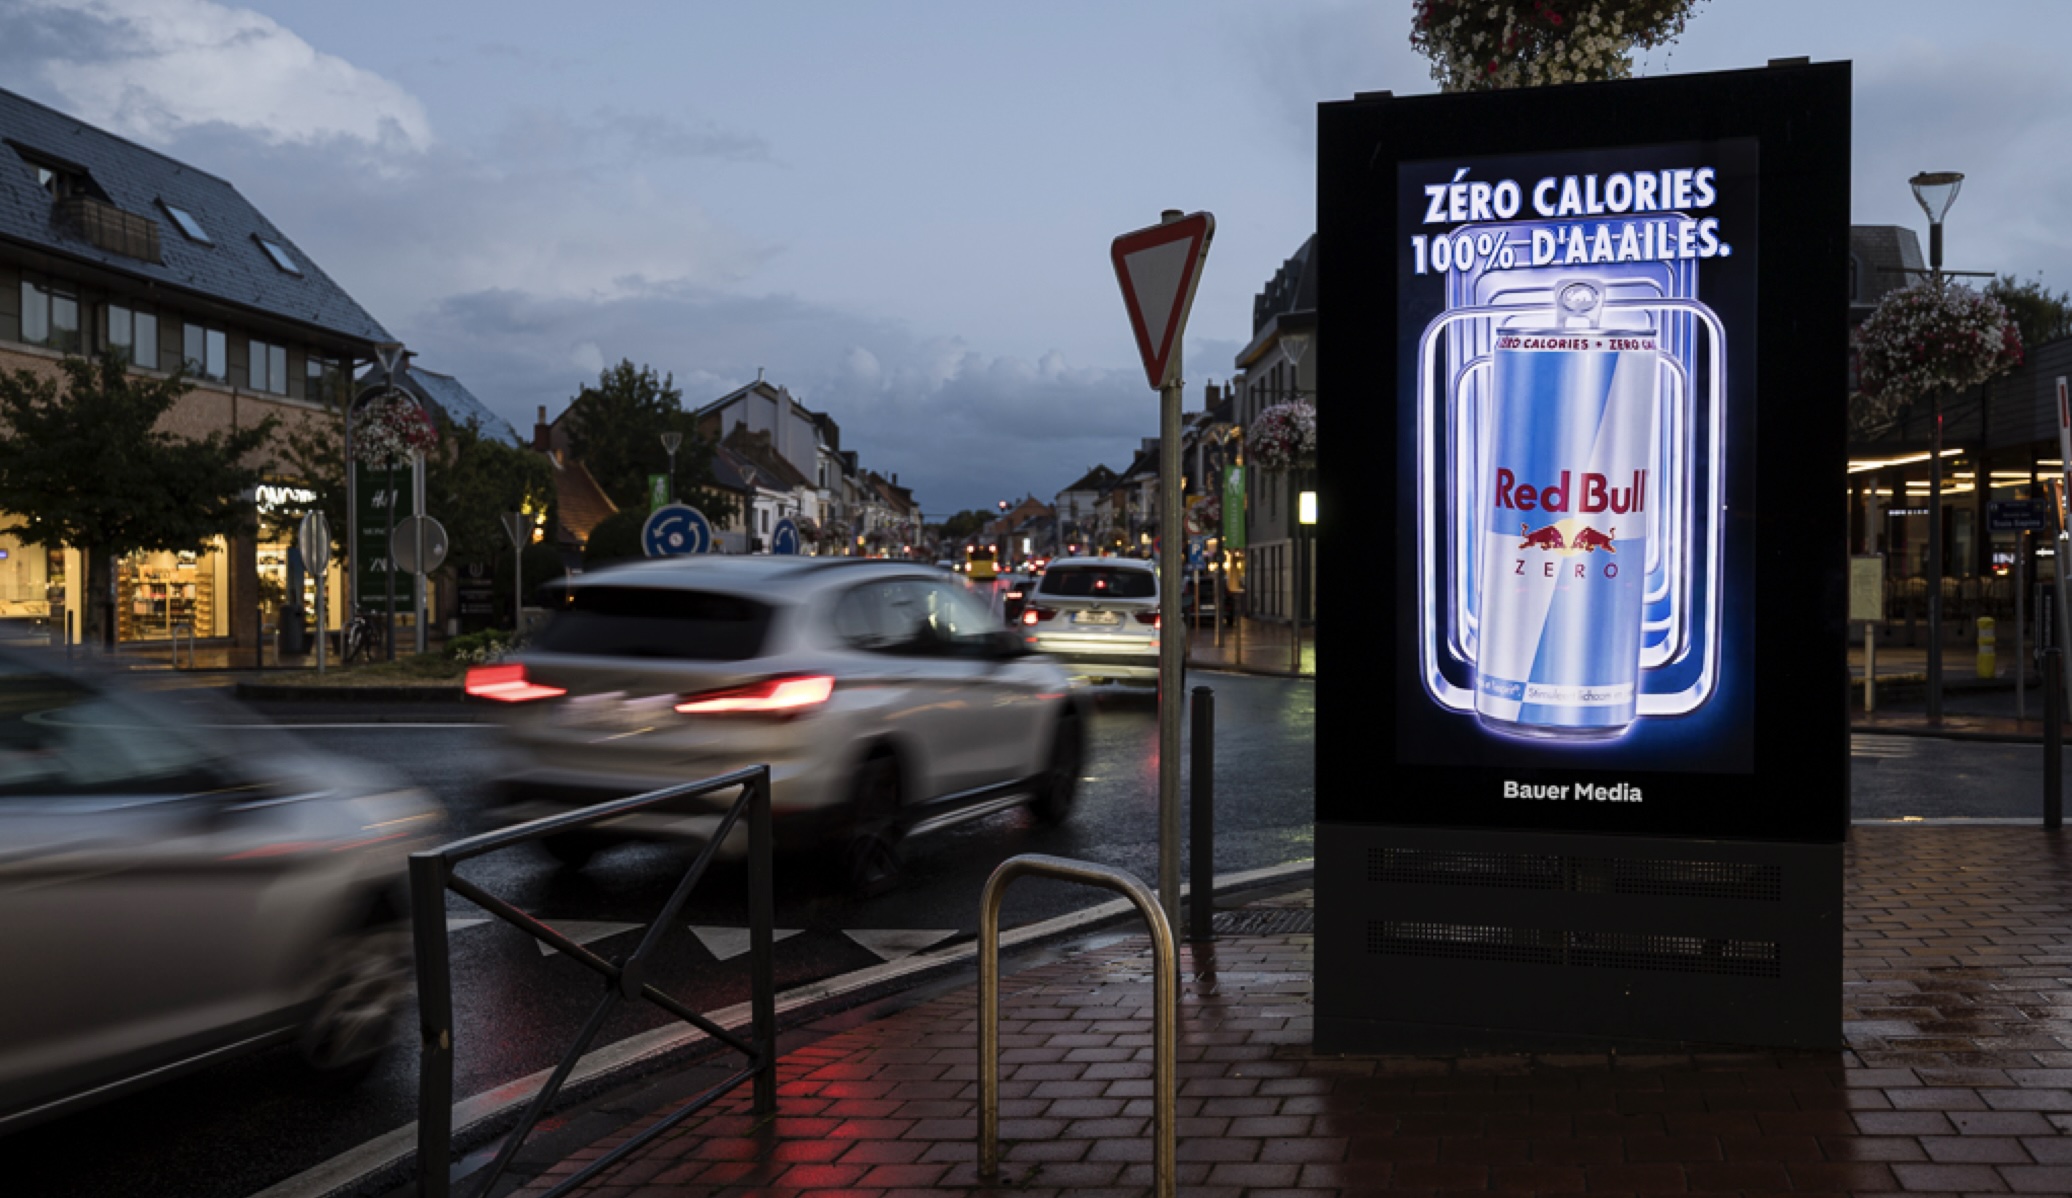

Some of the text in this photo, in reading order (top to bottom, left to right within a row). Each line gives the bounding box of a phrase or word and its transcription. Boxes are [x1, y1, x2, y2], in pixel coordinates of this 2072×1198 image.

[1423, 167, 1716, 224] ZÉRO CALORIES
[1411, 219, 1732, 275] 100% D'AAAILES.
[1523, 337, 1588, 350] CALORIES
[1495, 467, 1646, 515] Red Bull
[1191, 543, 1201, 556] P
[1515, 560, 1618, 578] ZERO
[1503, 781, 1642, 802] Bauer Media
